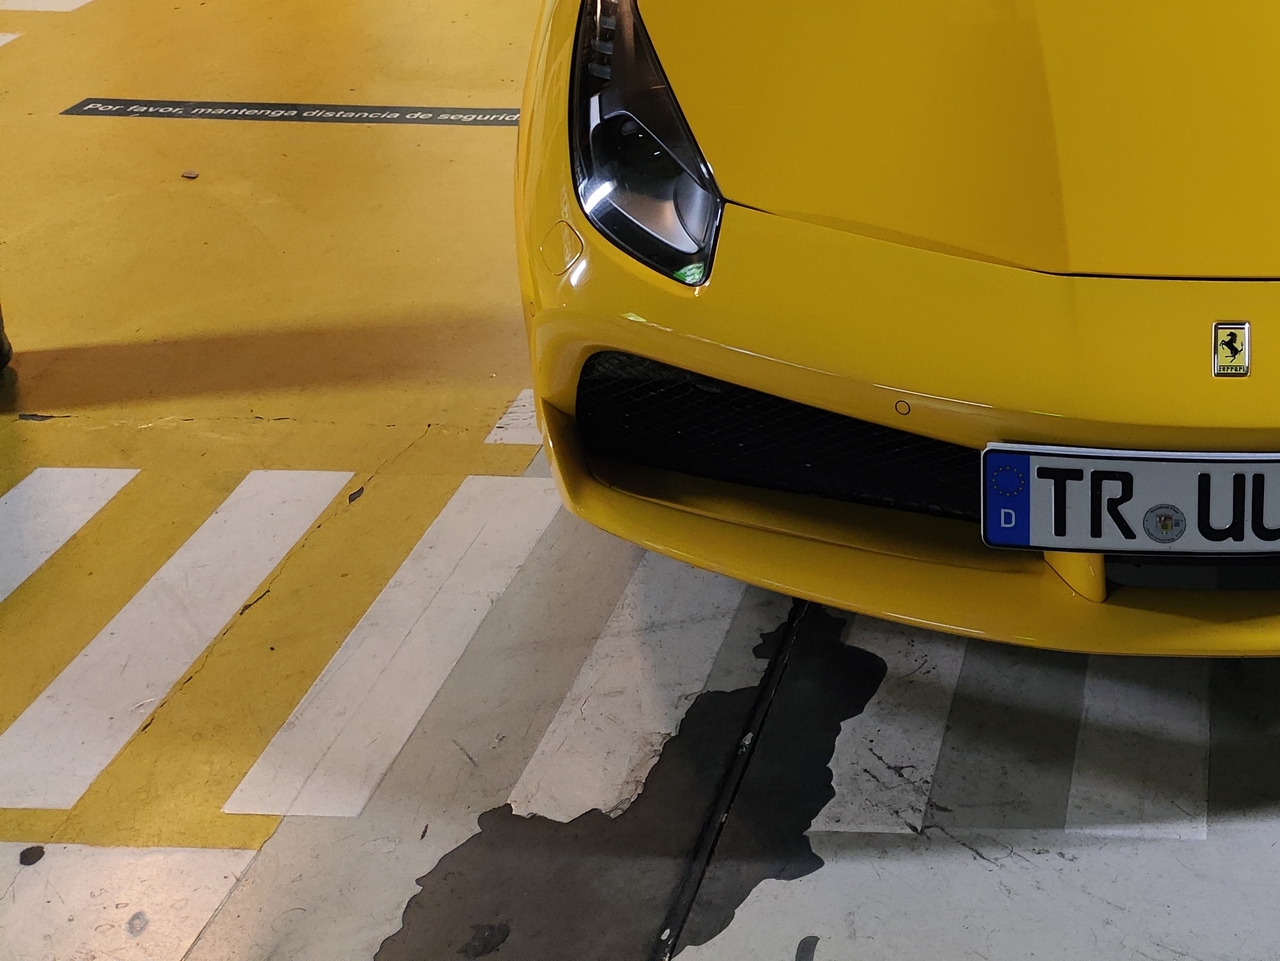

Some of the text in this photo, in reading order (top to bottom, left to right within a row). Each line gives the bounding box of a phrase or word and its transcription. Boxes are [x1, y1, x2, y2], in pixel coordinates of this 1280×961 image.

[83, 103, 520, 122] Por favor, mantenga distancia de segurid
[1036, 466, 1137, 540] TR
[1000, 508, 1016, 528] D
